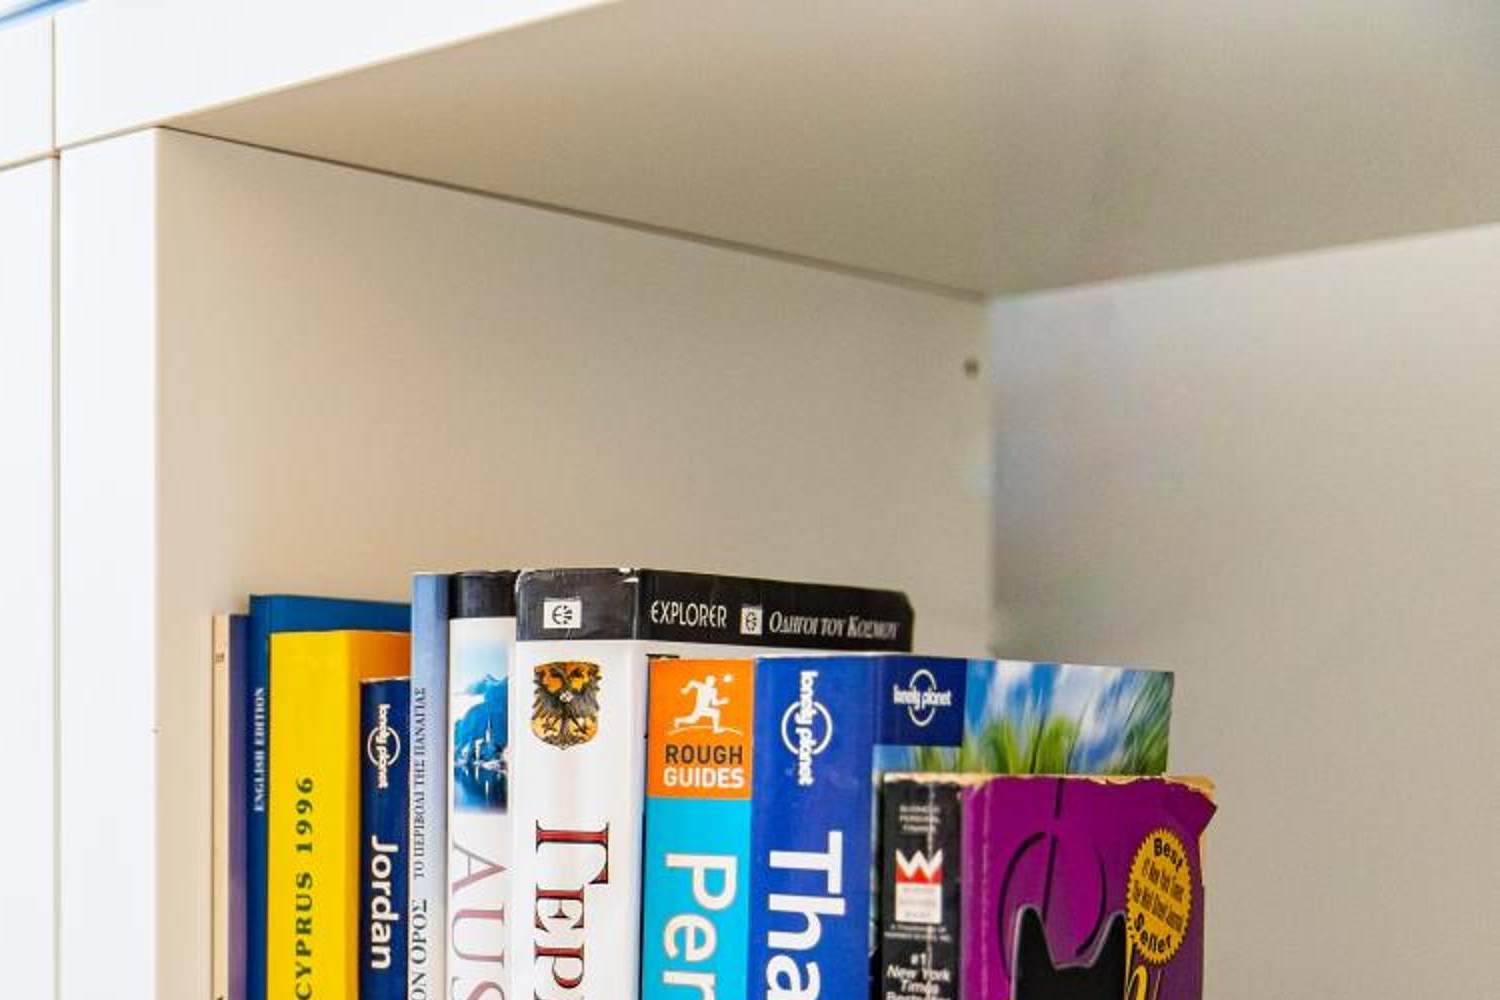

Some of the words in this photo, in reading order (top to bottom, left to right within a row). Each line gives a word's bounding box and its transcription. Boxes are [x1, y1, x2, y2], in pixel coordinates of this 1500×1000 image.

[651, 600, 728, 629] EXPLORER
[254, 688, 265, 746] EDITION
[794, 670, 818, 725] lonely
[893, 684, 920, 710] lonely
[921, 688, 952, 710] planet
[375, 703, 391, 744] lonely
[375, 745, 391, 789] planet
[665, 745, 743, 765] ROUGH
[794, 727, 817, 786] planet
[254, 750, 265, 812] ENGLISH
[663, 767, 744, 789] GUIDES
[296, 777, 314, 853] 1996
[1154, 837, 1182, 872] Best
[371, 835, 400, 969] Jordan
[411, 899, 427, 965] ΟΡΟΣ
[1134, 913, 1171, 953] Seller
[886, 964, 918, 979] New
[921, 968, 951, 982] York
[901, 979, 939, 994] Times
